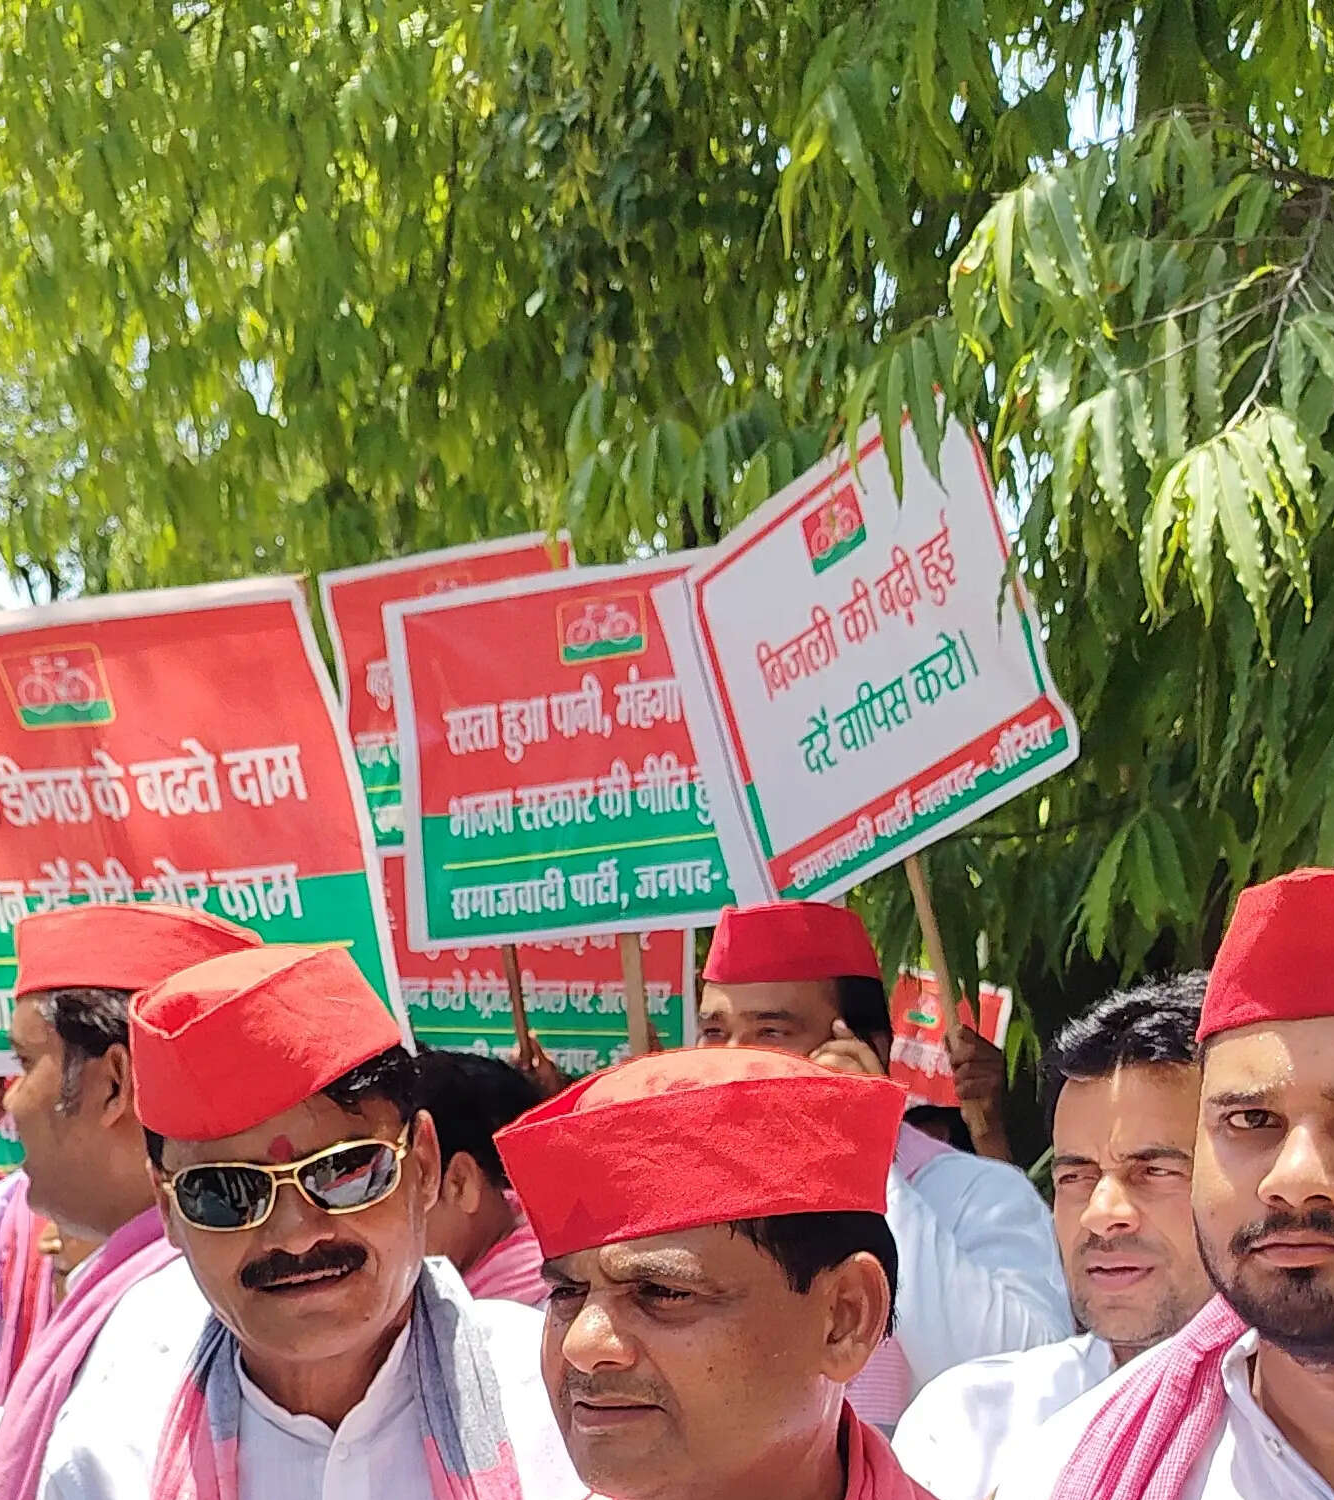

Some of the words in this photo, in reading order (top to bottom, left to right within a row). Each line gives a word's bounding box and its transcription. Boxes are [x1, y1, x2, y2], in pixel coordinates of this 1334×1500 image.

[755, 604, 840, 702] बिजली
[838, 576, 878, 645] की
[916, 508, 957, 607] हुई
[798, 706, 838, 776] दरें
[834, 676, 913, 752] वापिस
[221, 743, 308, 806] दाम
[210, 862, 304, 922] काम
